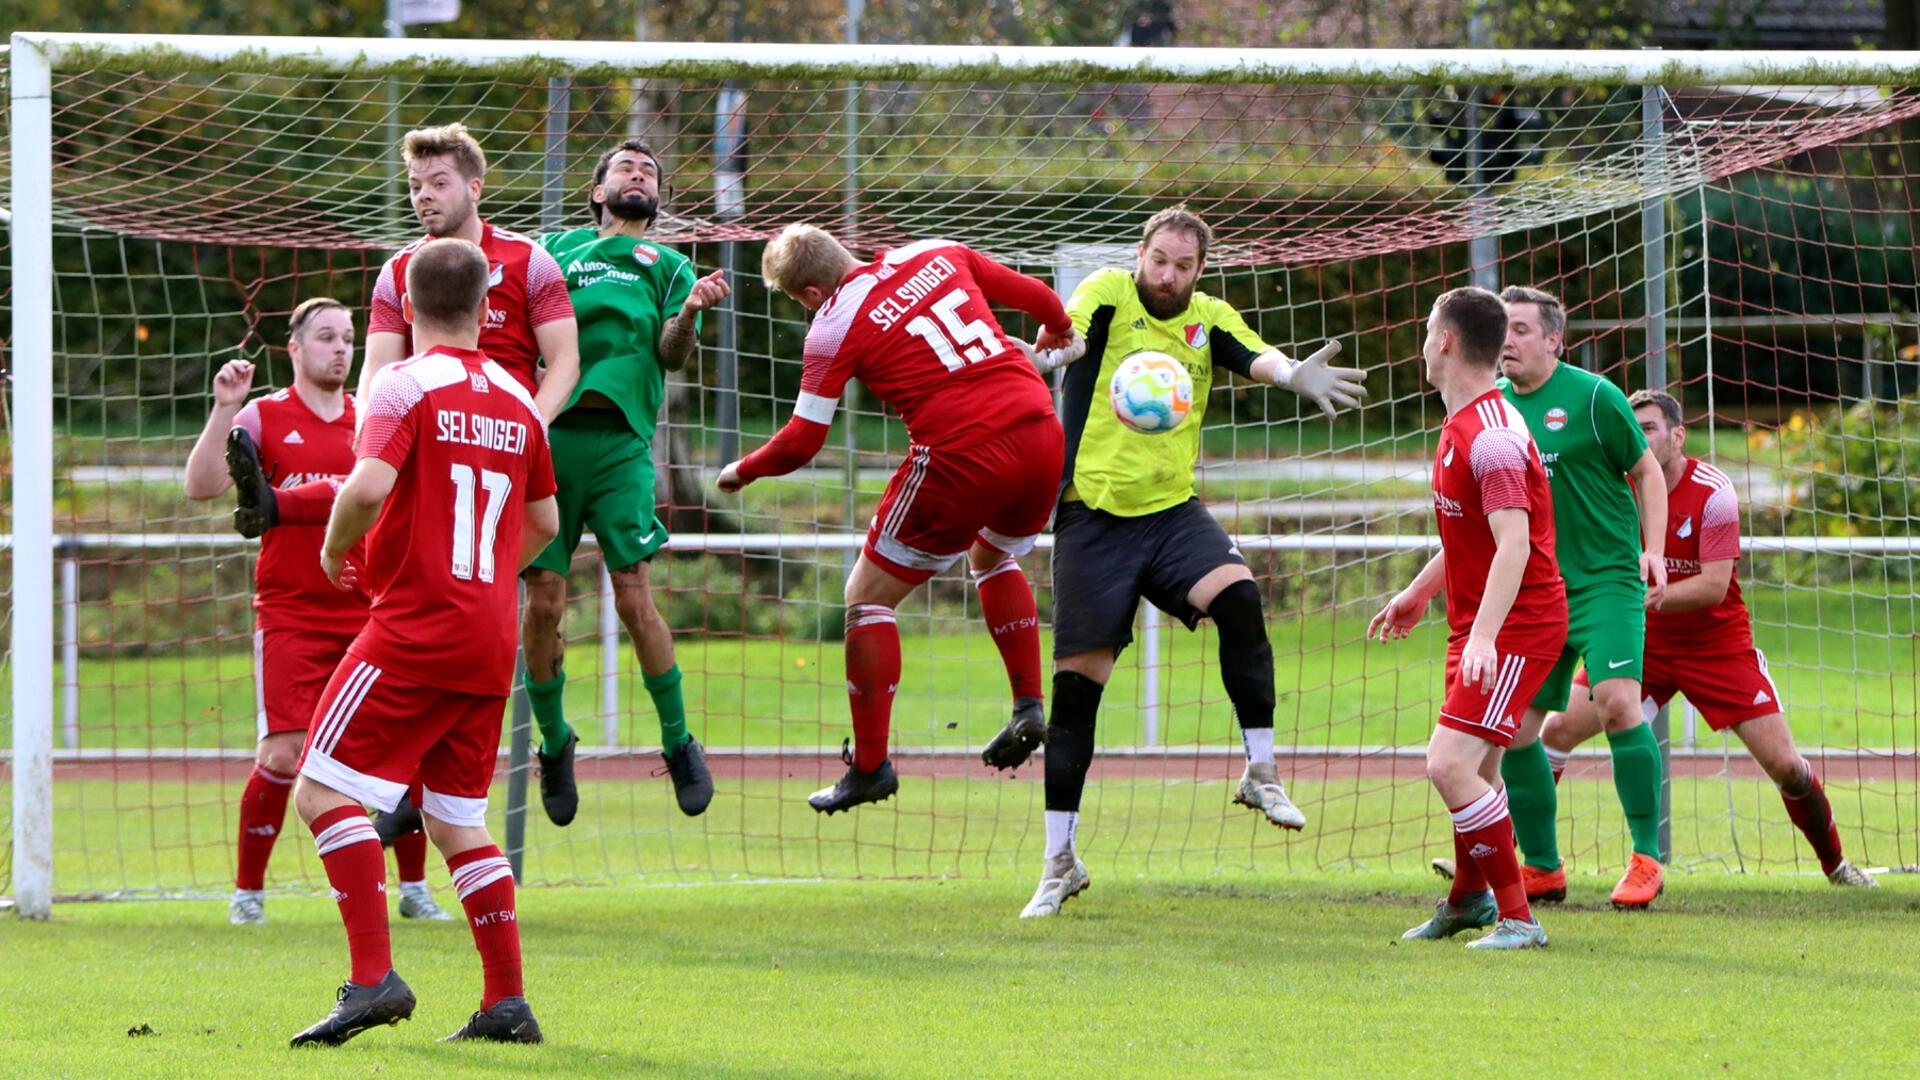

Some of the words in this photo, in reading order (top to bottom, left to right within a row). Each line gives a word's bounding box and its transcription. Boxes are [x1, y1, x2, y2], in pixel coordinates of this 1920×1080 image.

[868, 255, 957, 332] SELSINGEN
[904, 287, 1006, 373] 15
[436, 410, 527, 456] SELSINGEN
[450, 463, 513, 584] 17
[993, 615, 1036, 635] MTSV
[473, 909, 515, 928] MTSV
